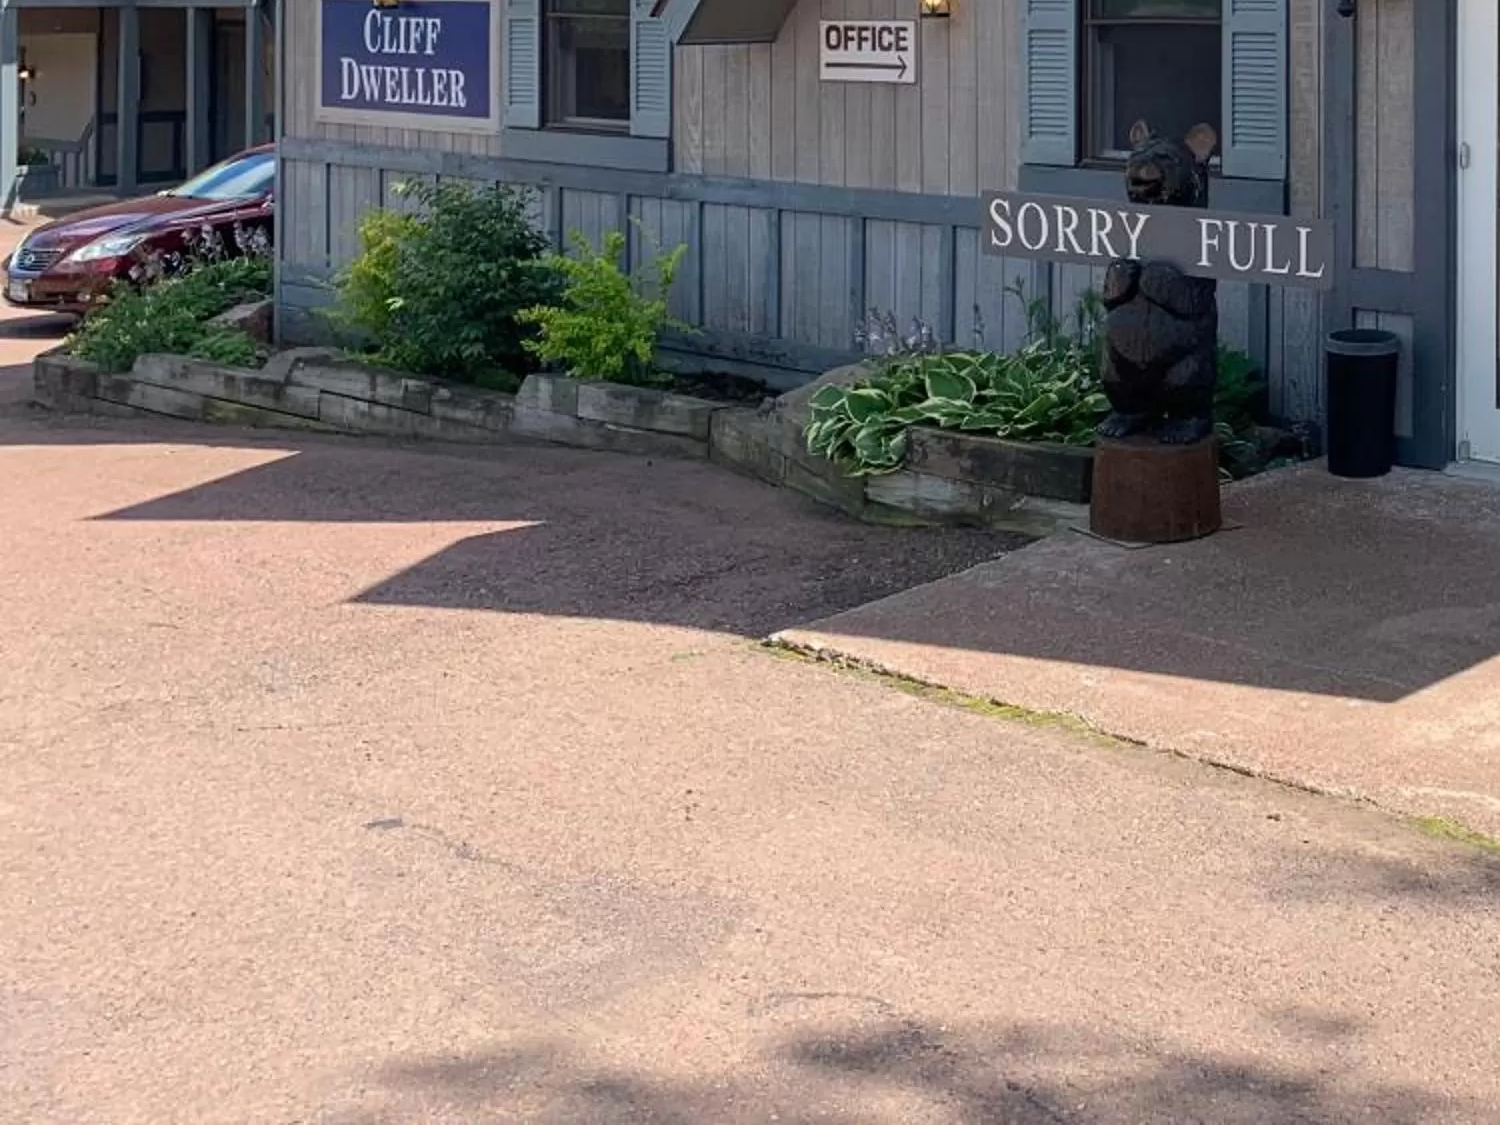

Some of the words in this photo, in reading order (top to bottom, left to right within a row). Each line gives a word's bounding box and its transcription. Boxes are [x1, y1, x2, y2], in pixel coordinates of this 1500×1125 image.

[363, 8, 441, 55] CLIFF
[825, 24, 909, 52] OFFICE
[340, 56, 467, 108] DWELLER
[989, 198, 1151, 260] SORRY
[1196, 218, 1326, 279] FULL
